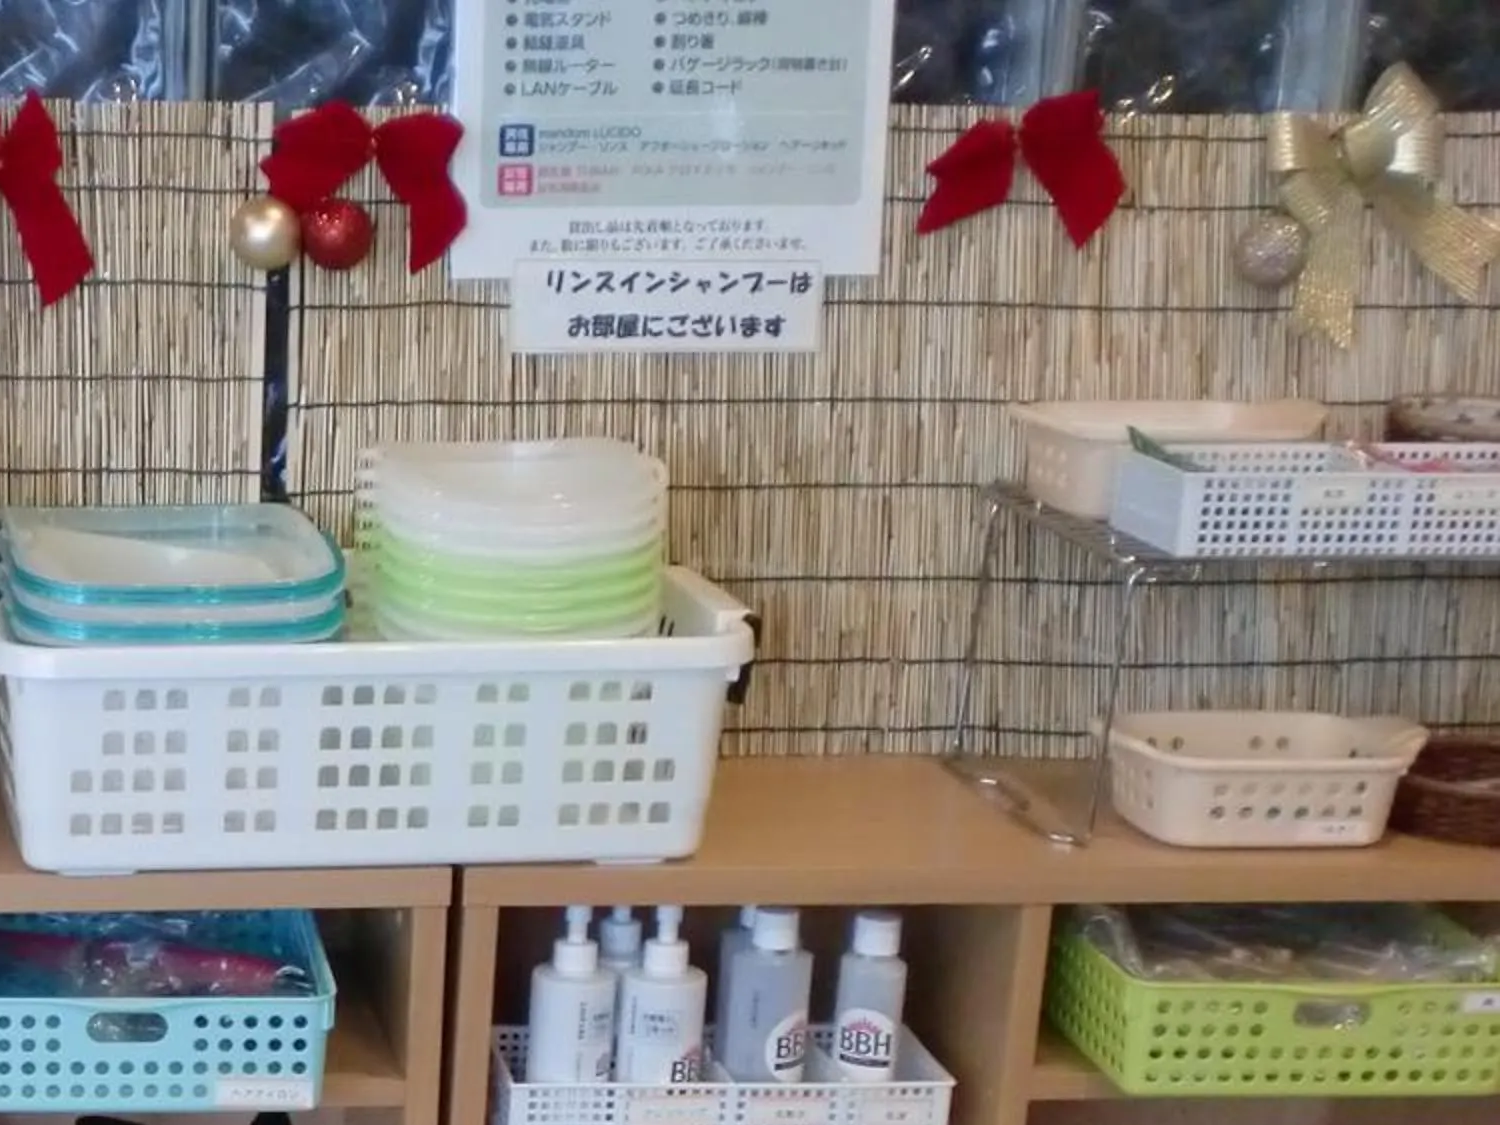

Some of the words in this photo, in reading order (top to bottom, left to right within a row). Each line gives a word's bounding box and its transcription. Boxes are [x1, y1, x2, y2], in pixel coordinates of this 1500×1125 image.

[520, 80, 620, 97] LANケーブル
[546, 269, 814, 295] リンスインシャンプーは
[566, 312, 788, 339] お部屋にございます
[840, 1030, 891, 1056] BBH
